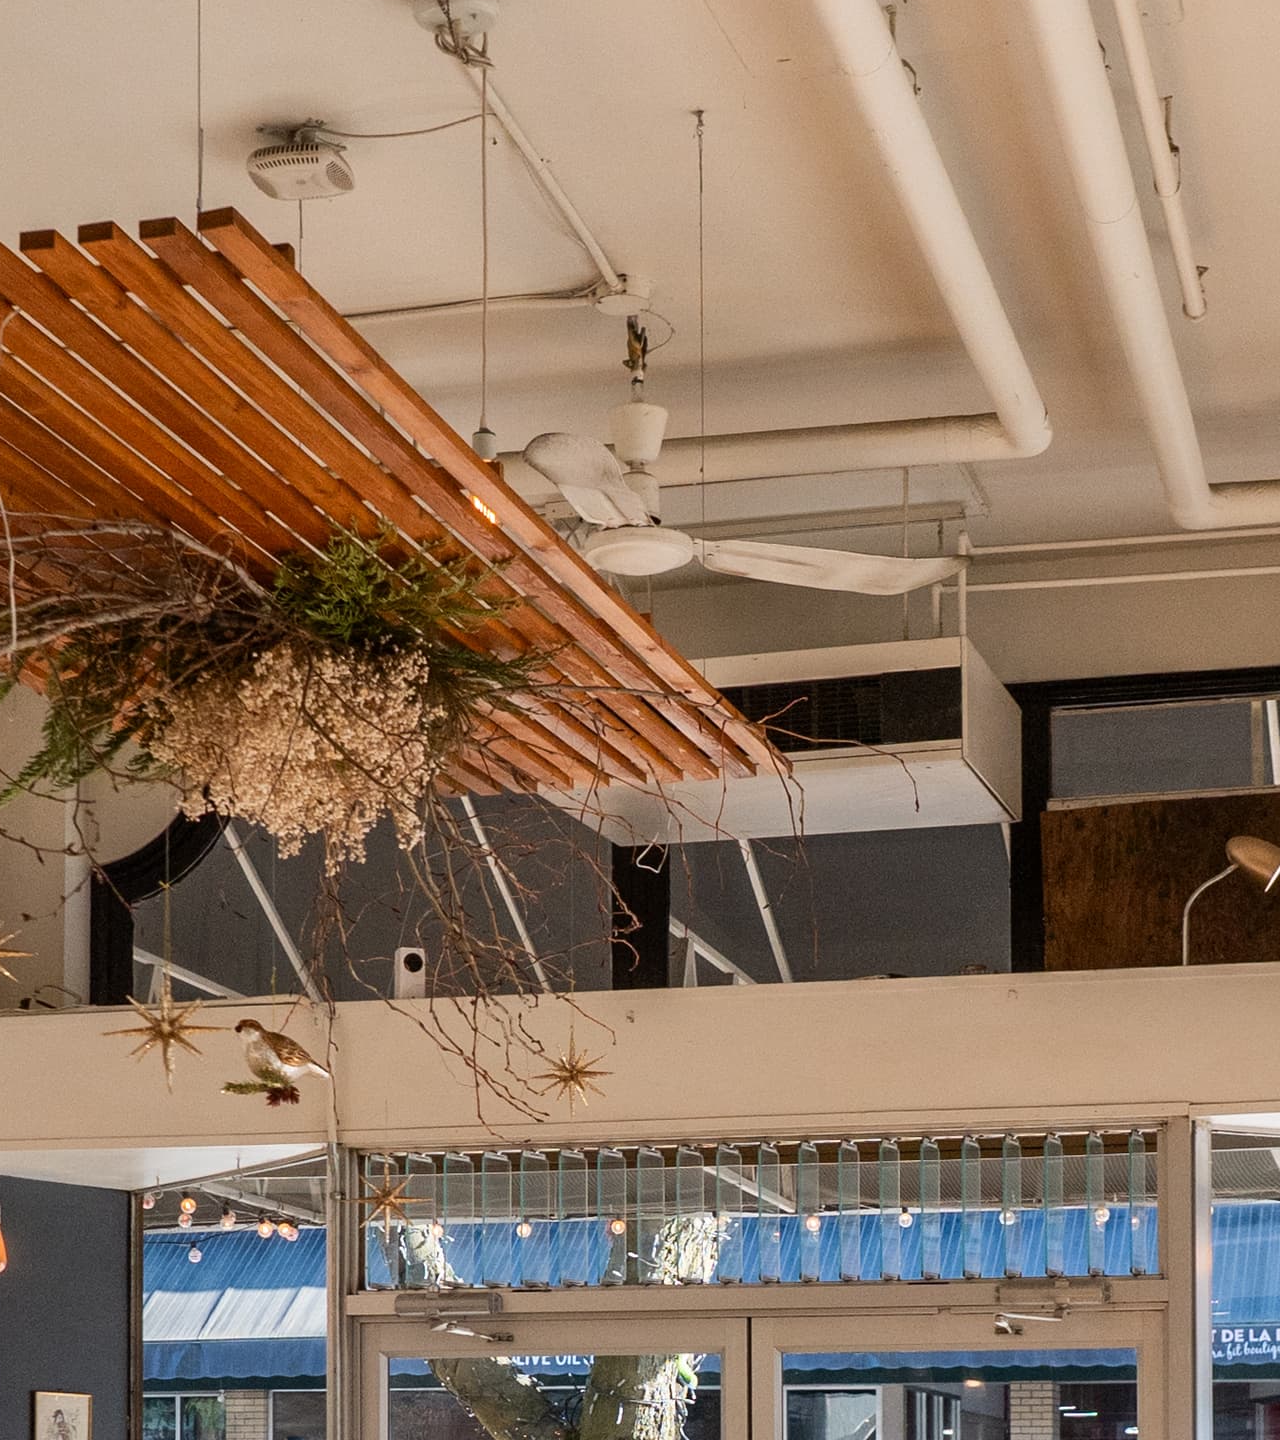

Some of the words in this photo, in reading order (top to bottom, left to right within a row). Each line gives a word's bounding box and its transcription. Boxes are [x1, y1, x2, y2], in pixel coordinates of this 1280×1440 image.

[1221, 1328, 1245, 1343] DE
[1248, 1327, 1272, 1342] LA
[1226, 1342, 1242, 1361] fit
